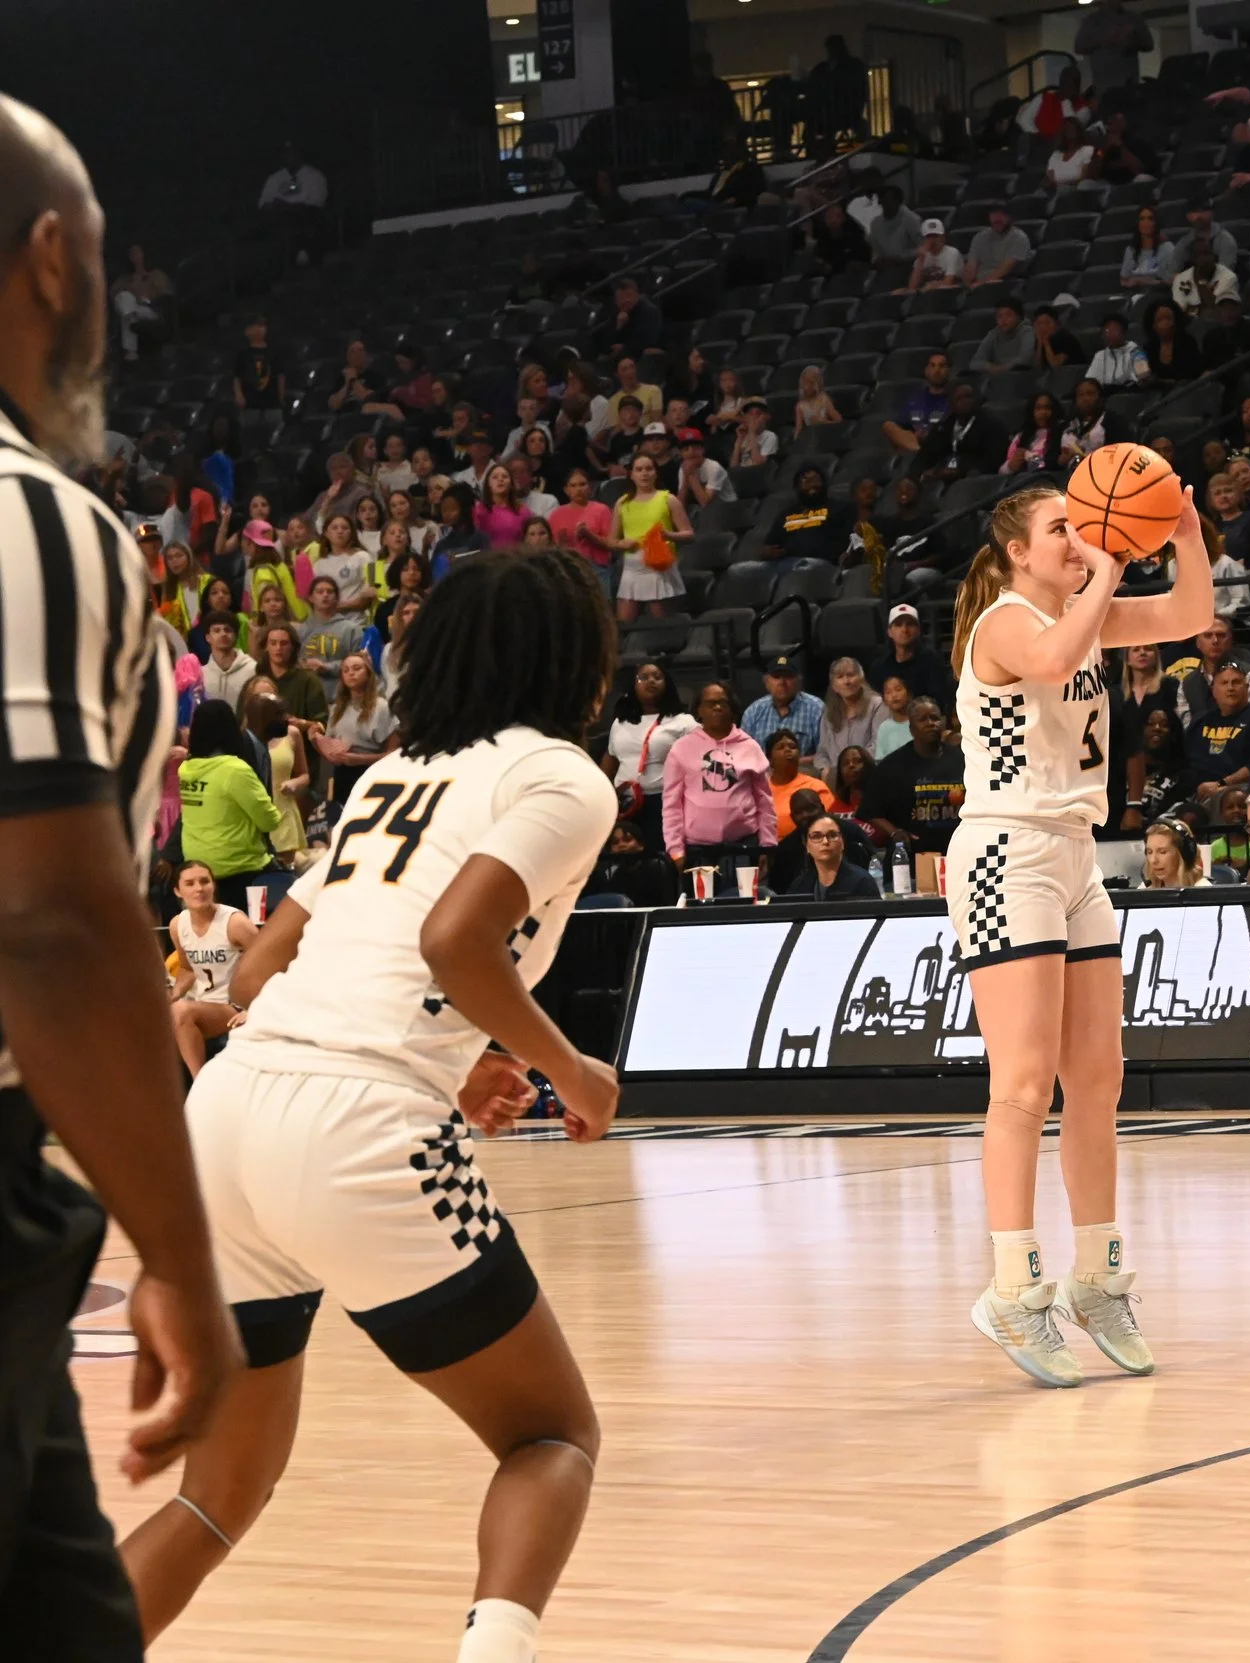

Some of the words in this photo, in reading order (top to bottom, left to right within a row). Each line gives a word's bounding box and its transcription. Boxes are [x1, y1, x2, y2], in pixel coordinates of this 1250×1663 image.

[544, 39, 571, 56] 127
[1079, 709, 1104, 771] 5
[322, 778, 455, 888] 24
